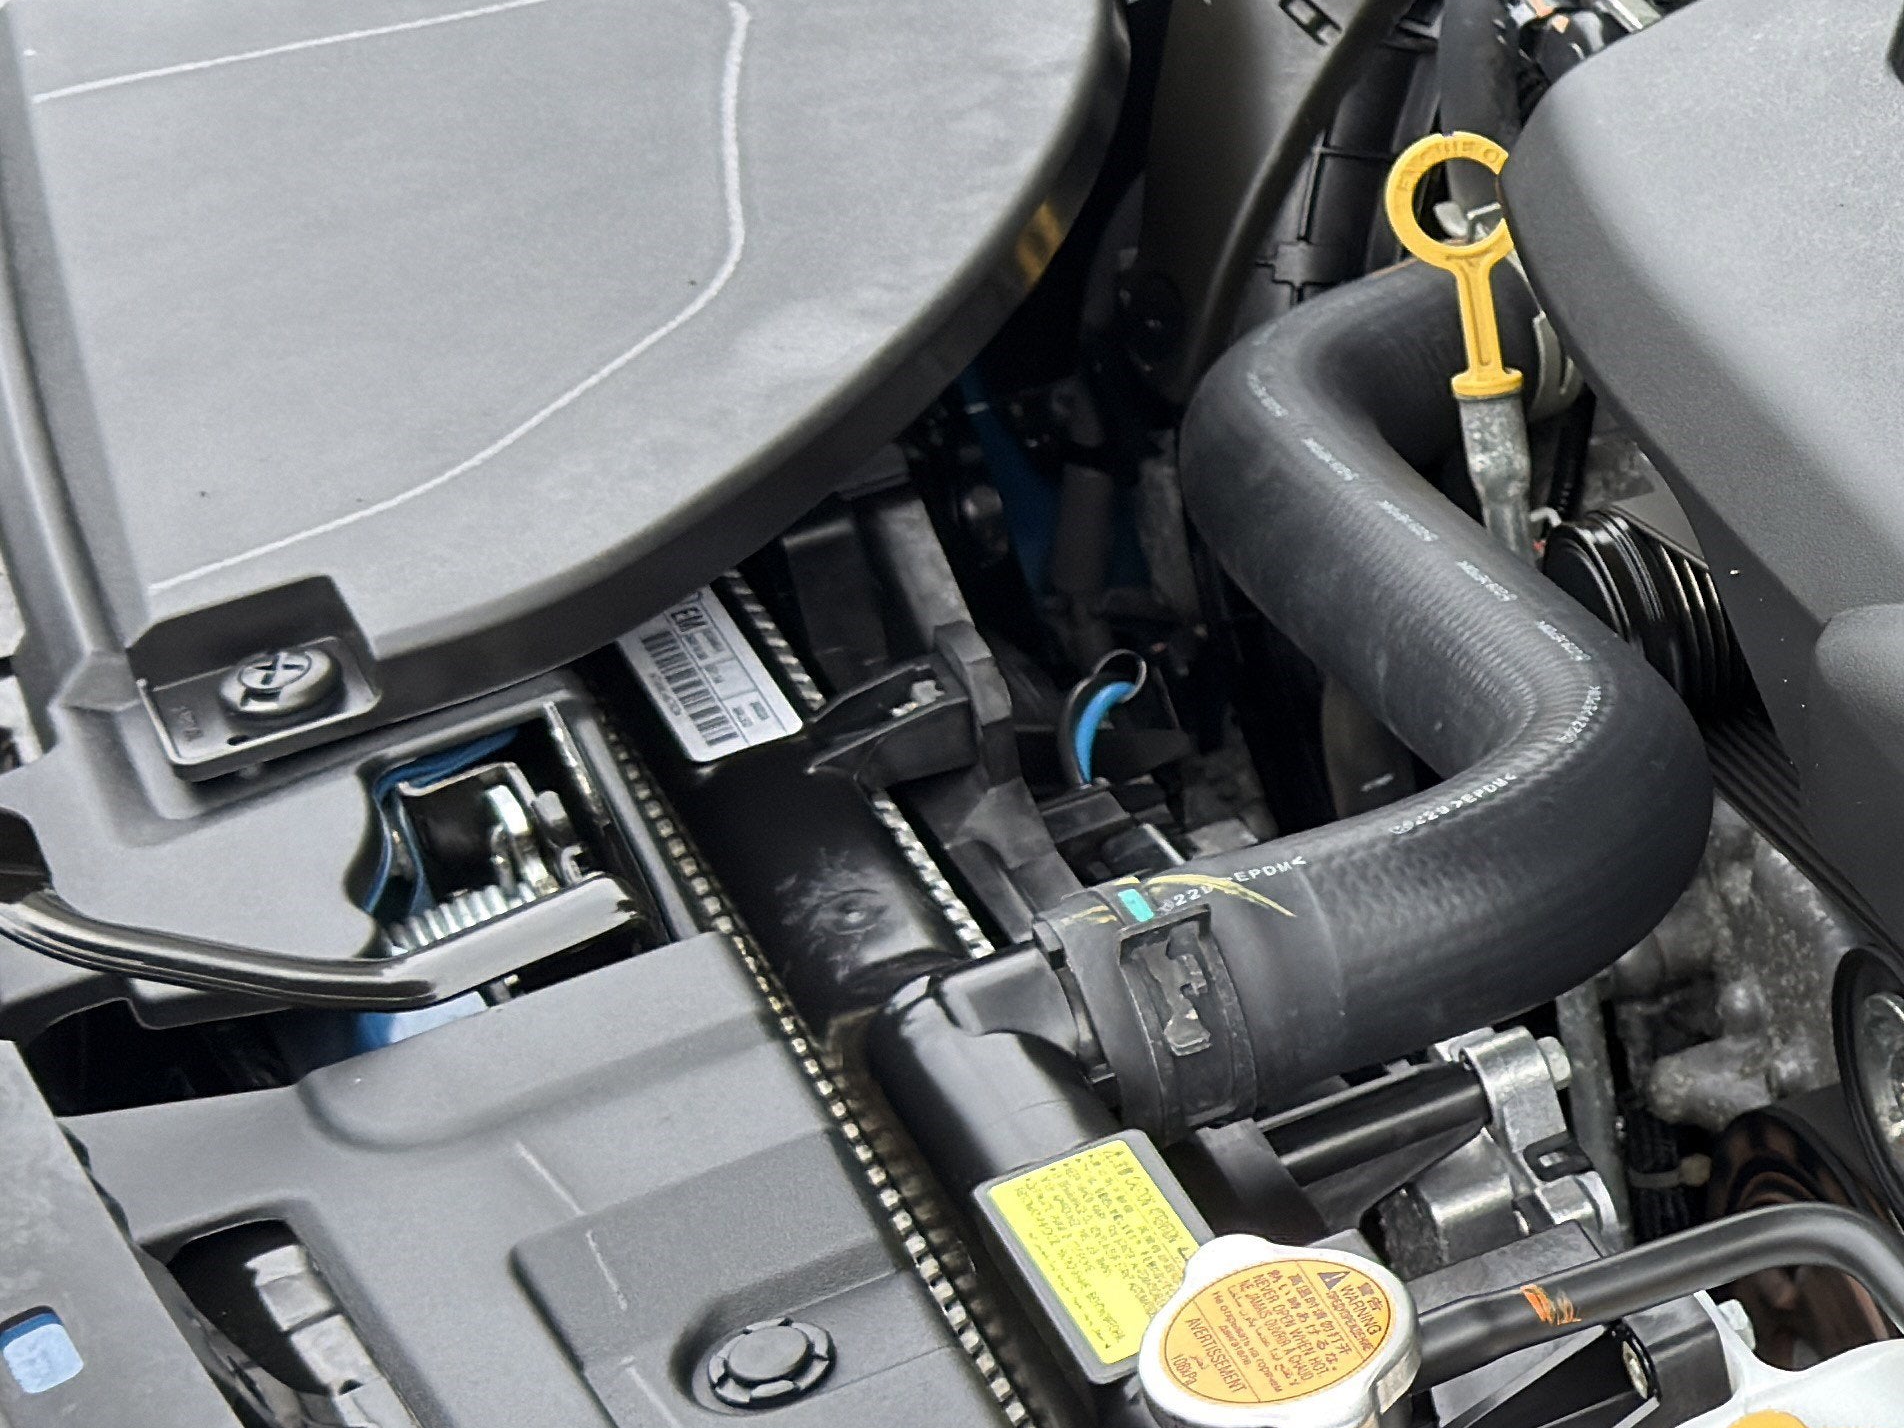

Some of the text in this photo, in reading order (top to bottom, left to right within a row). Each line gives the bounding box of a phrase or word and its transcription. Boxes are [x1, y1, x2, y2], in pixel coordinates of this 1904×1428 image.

[1244, 1291, 1273, 1318] JAMAIS
[1287, 1355, 1314, 1380] CHAUD
[1252, 1274, 1280, 1301] NEVER
[1271, 1304, 1297, 1327] OPEN
[1289, 1328, 1316, 1354] WHEN
[1341, 1284, 1382, 1335] WARNING
[1187, 1316, 1248, 1393] AVERTISSEMENT
